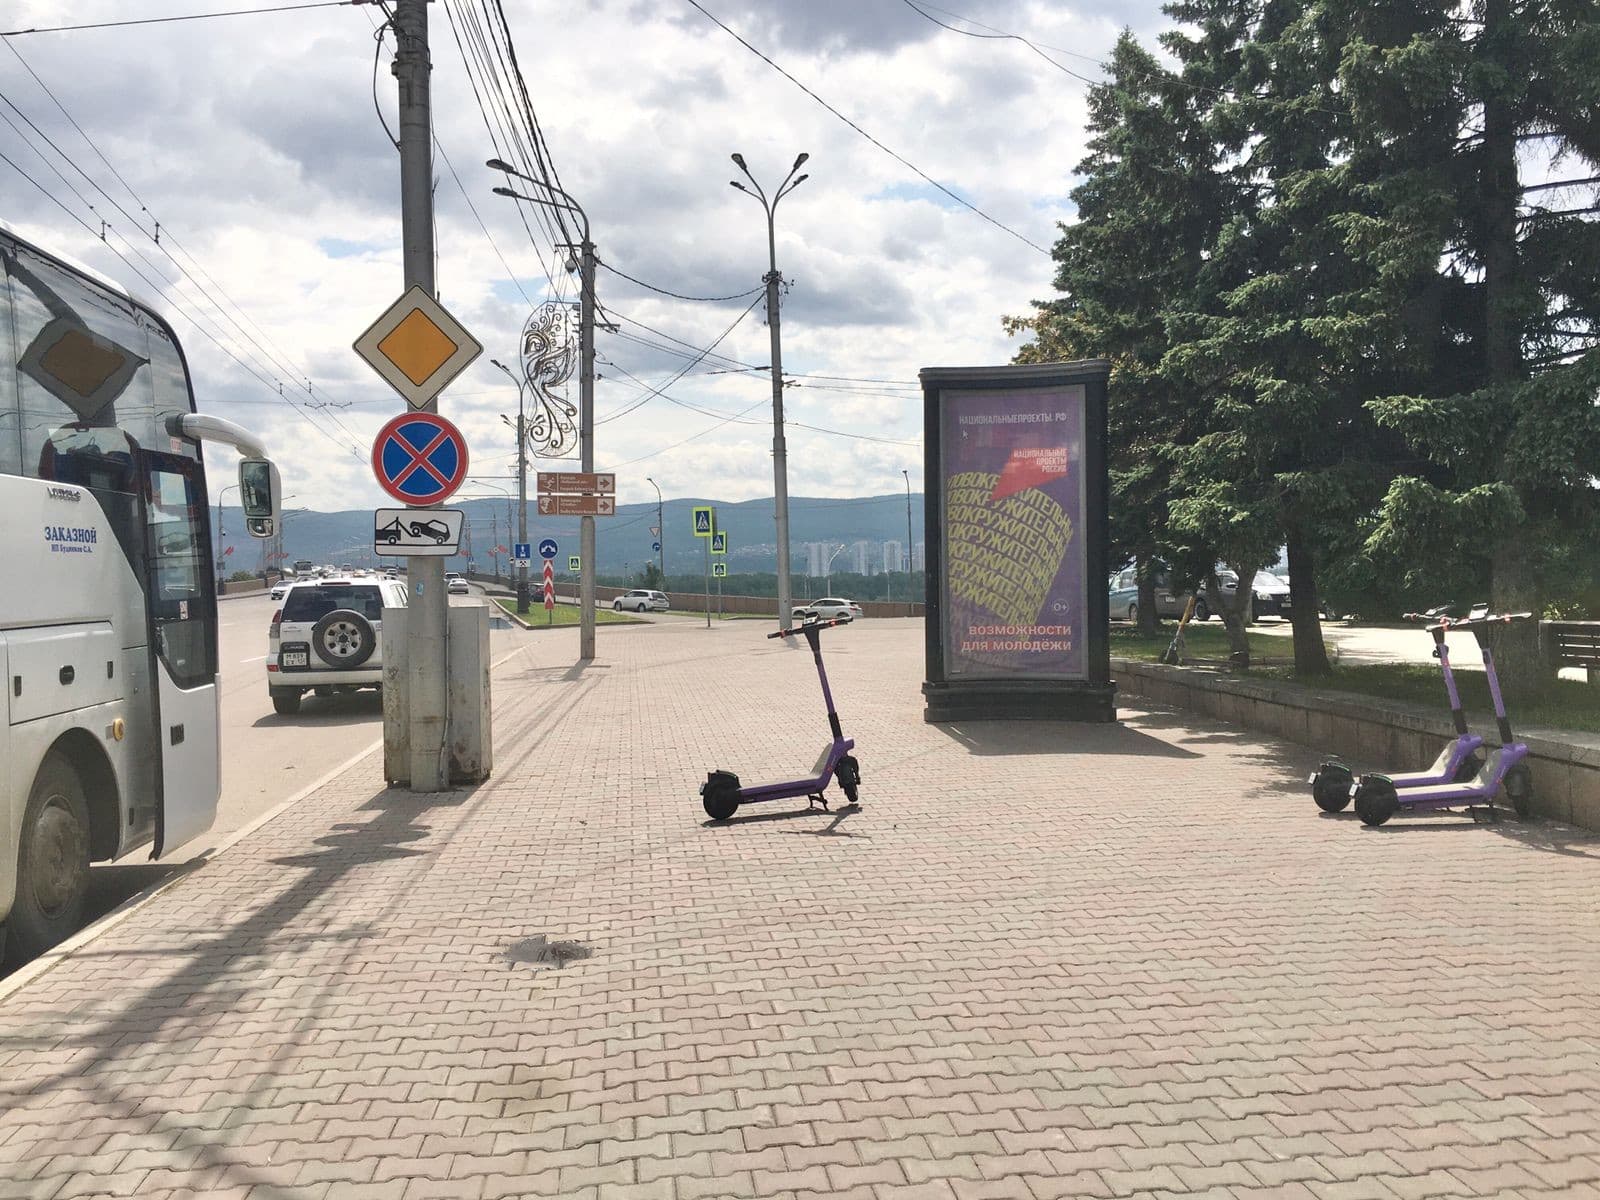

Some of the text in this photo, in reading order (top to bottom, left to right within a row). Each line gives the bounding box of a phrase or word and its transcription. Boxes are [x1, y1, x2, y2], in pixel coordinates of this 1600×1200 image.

[1013, 447, 1067, 458] НАЦИОНАЛЬНЫЕ
[1036, 457, 1067, 466] ПРОЕКТЫ
[44, 526, 97, 544] ЗАКАЗНОЙ
[1053, 602, 1068, 611] 0+
[961, 638, 1072, 653] для молодёжи
